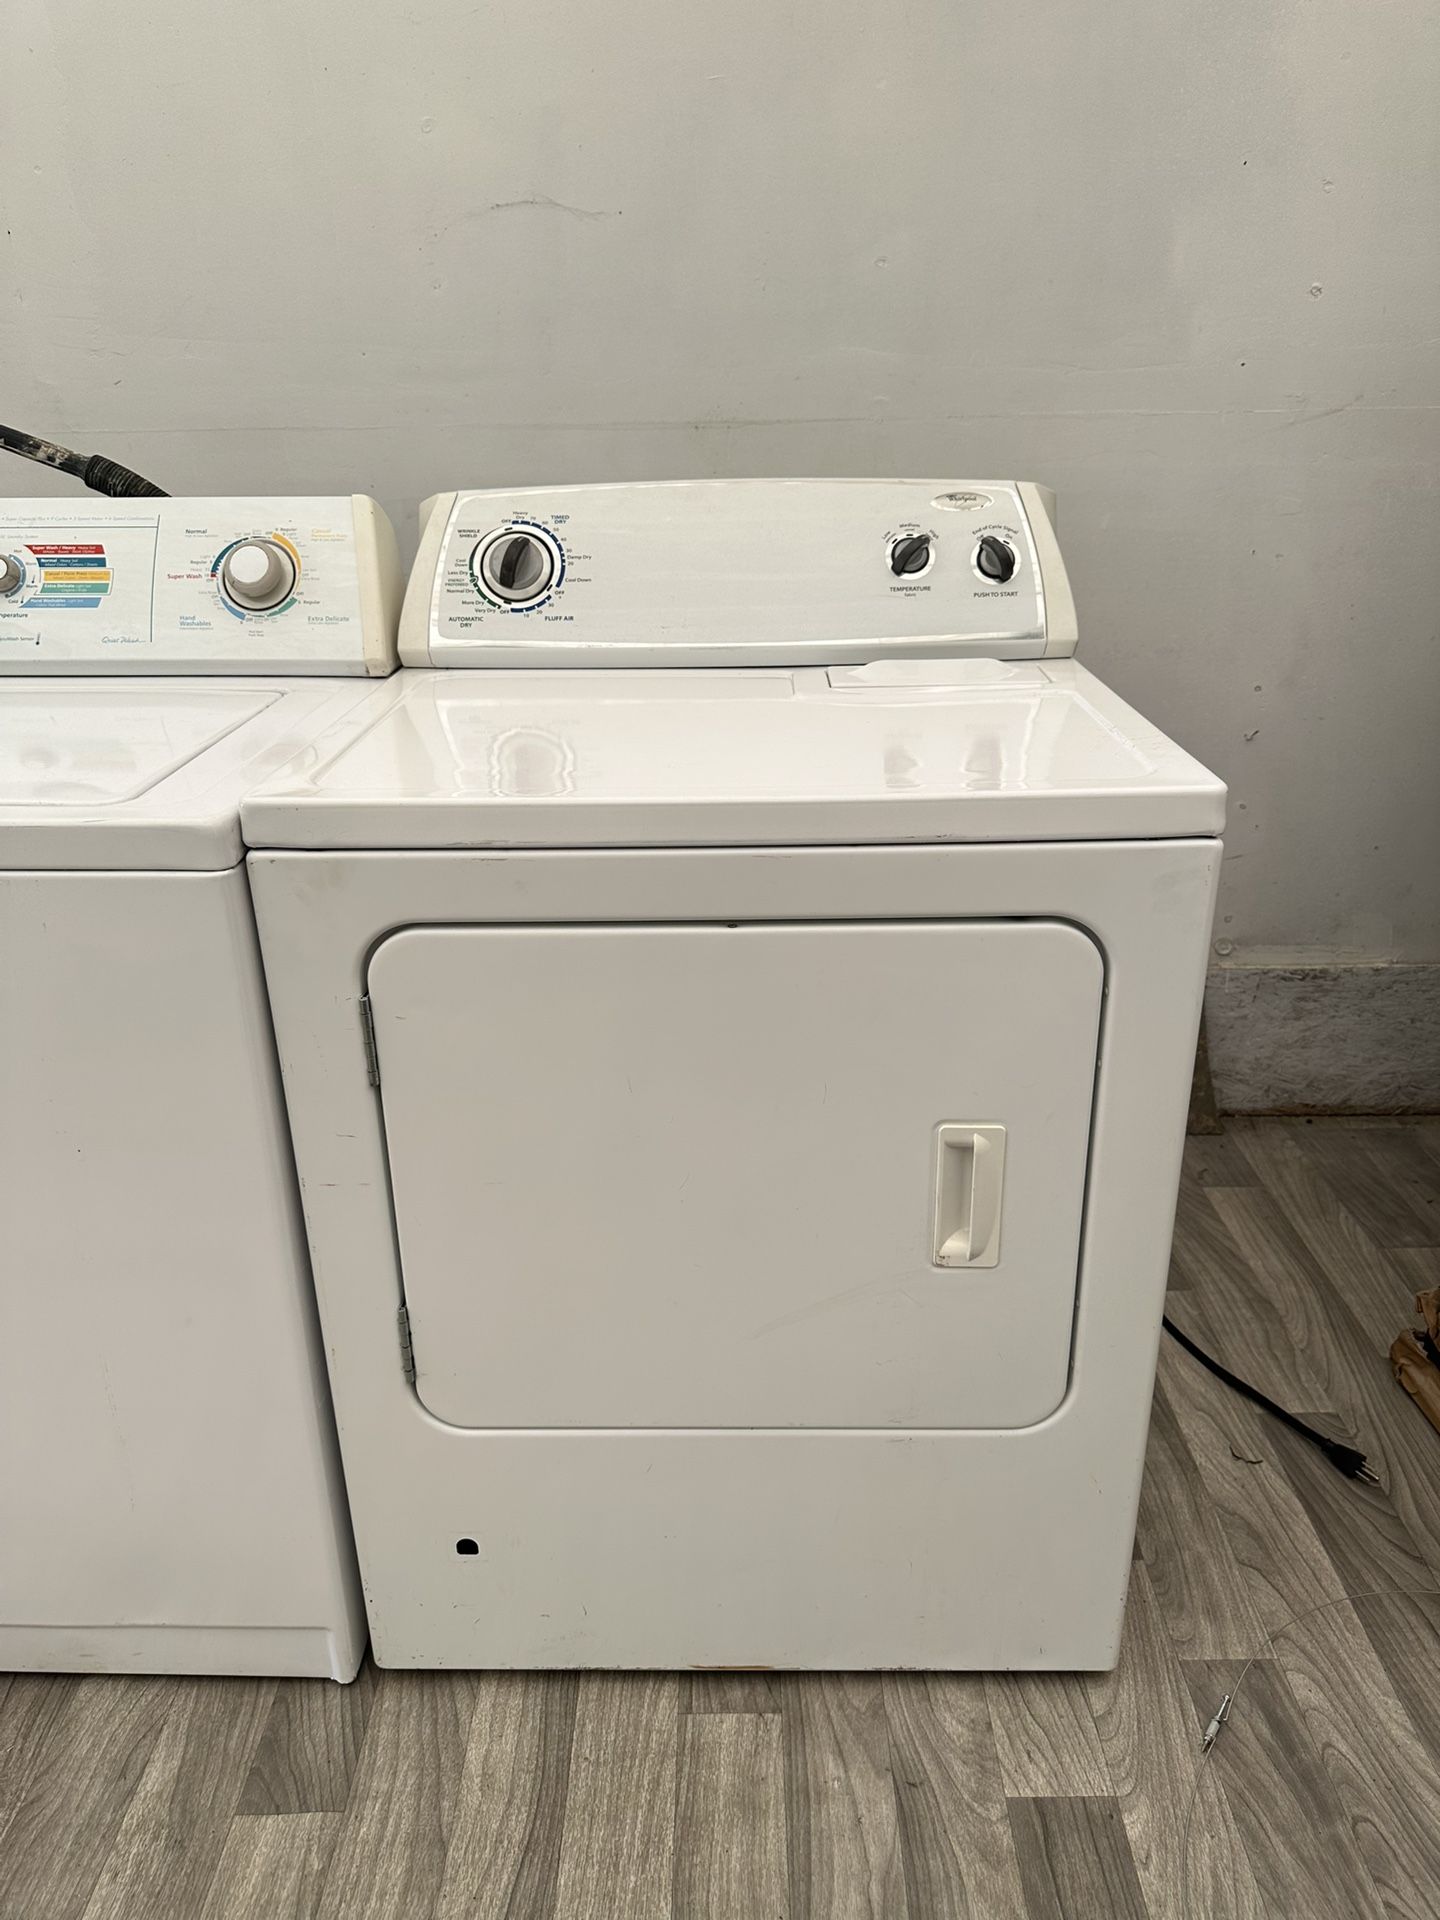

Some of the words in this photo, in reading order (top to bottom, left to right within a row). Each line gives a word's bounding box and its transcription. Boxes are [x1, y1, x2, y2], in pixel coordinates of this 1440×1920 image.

[946, 494, 977, 502] Whirlpool
[972, 527, 982, 535] End
[1003, 525, 1019, 535] Signal
